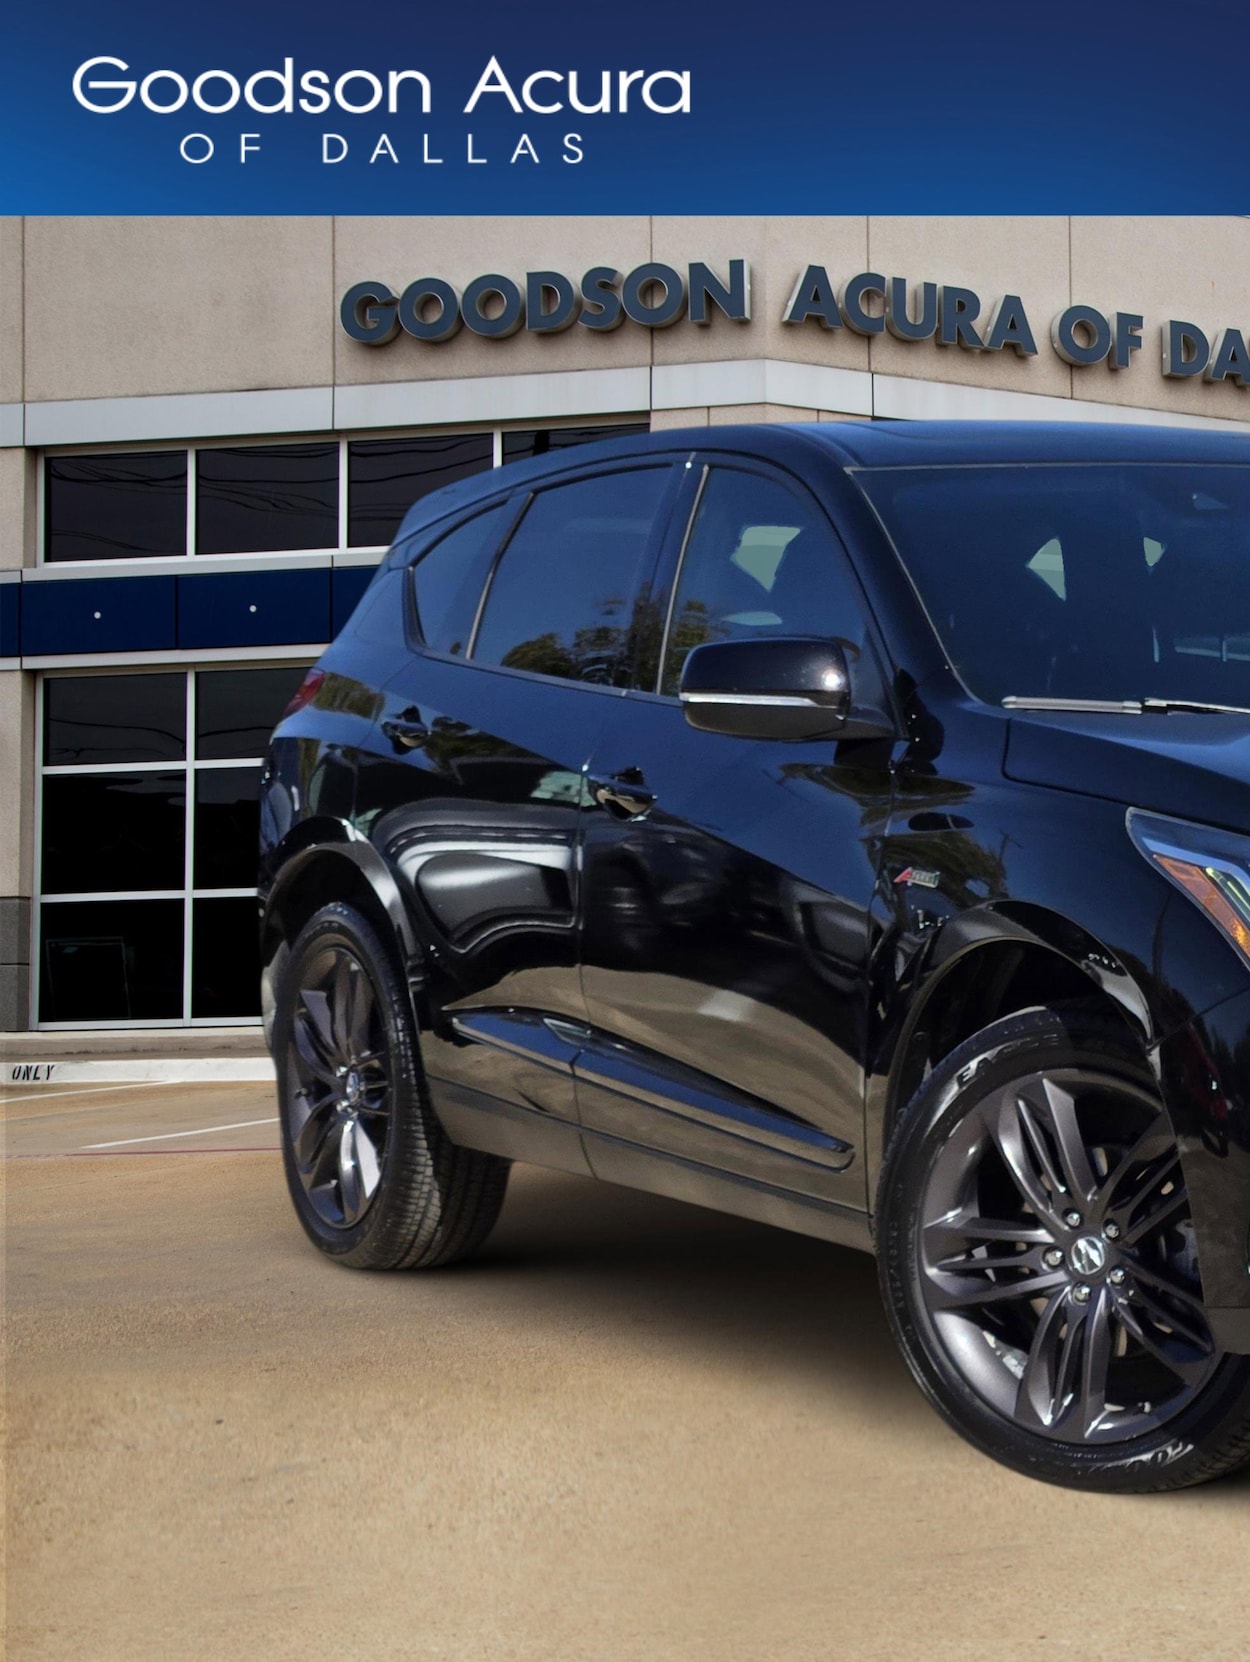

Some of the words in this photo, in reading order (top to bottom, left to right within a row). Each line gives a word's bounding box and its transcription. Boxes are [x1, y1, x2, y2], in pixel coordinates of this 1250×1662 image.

[340, 259, 751, 345] GOODSON
[782, 264, 1038, 357] ACURA
[1051, 304, 1143, 369] OF
[12, 1064, 55, 1081] ONLY
